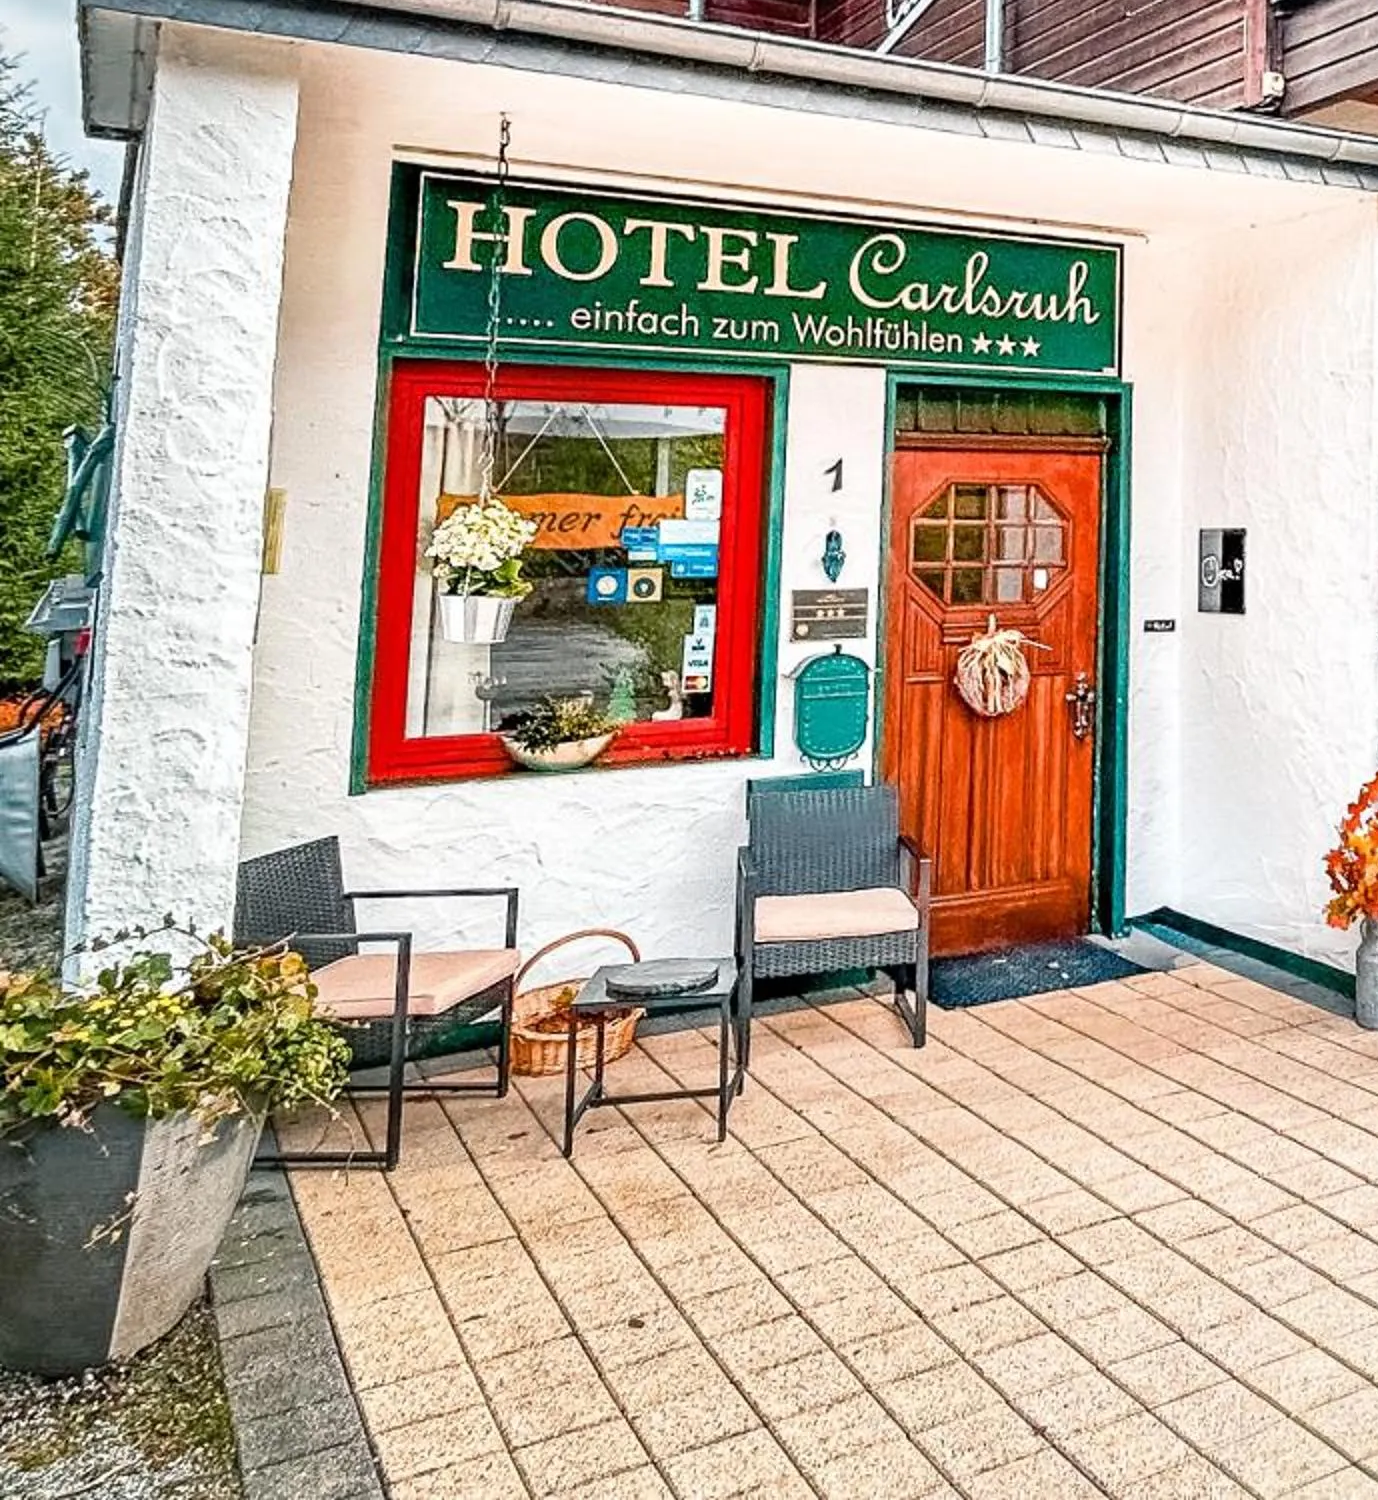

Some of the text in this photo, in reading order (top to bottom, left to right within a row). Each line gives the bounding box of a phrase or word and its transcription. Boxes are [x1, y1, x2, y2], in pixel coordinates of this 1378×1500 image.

[442, 199, 1100, 325] HOTEL Carlsruh
[570, 299, 700, 337] einfach
[712, 317, 780, 343] zum
[791, 311, 964, 354] Wohlfühlen
[823, 457, 844, 493] 1
